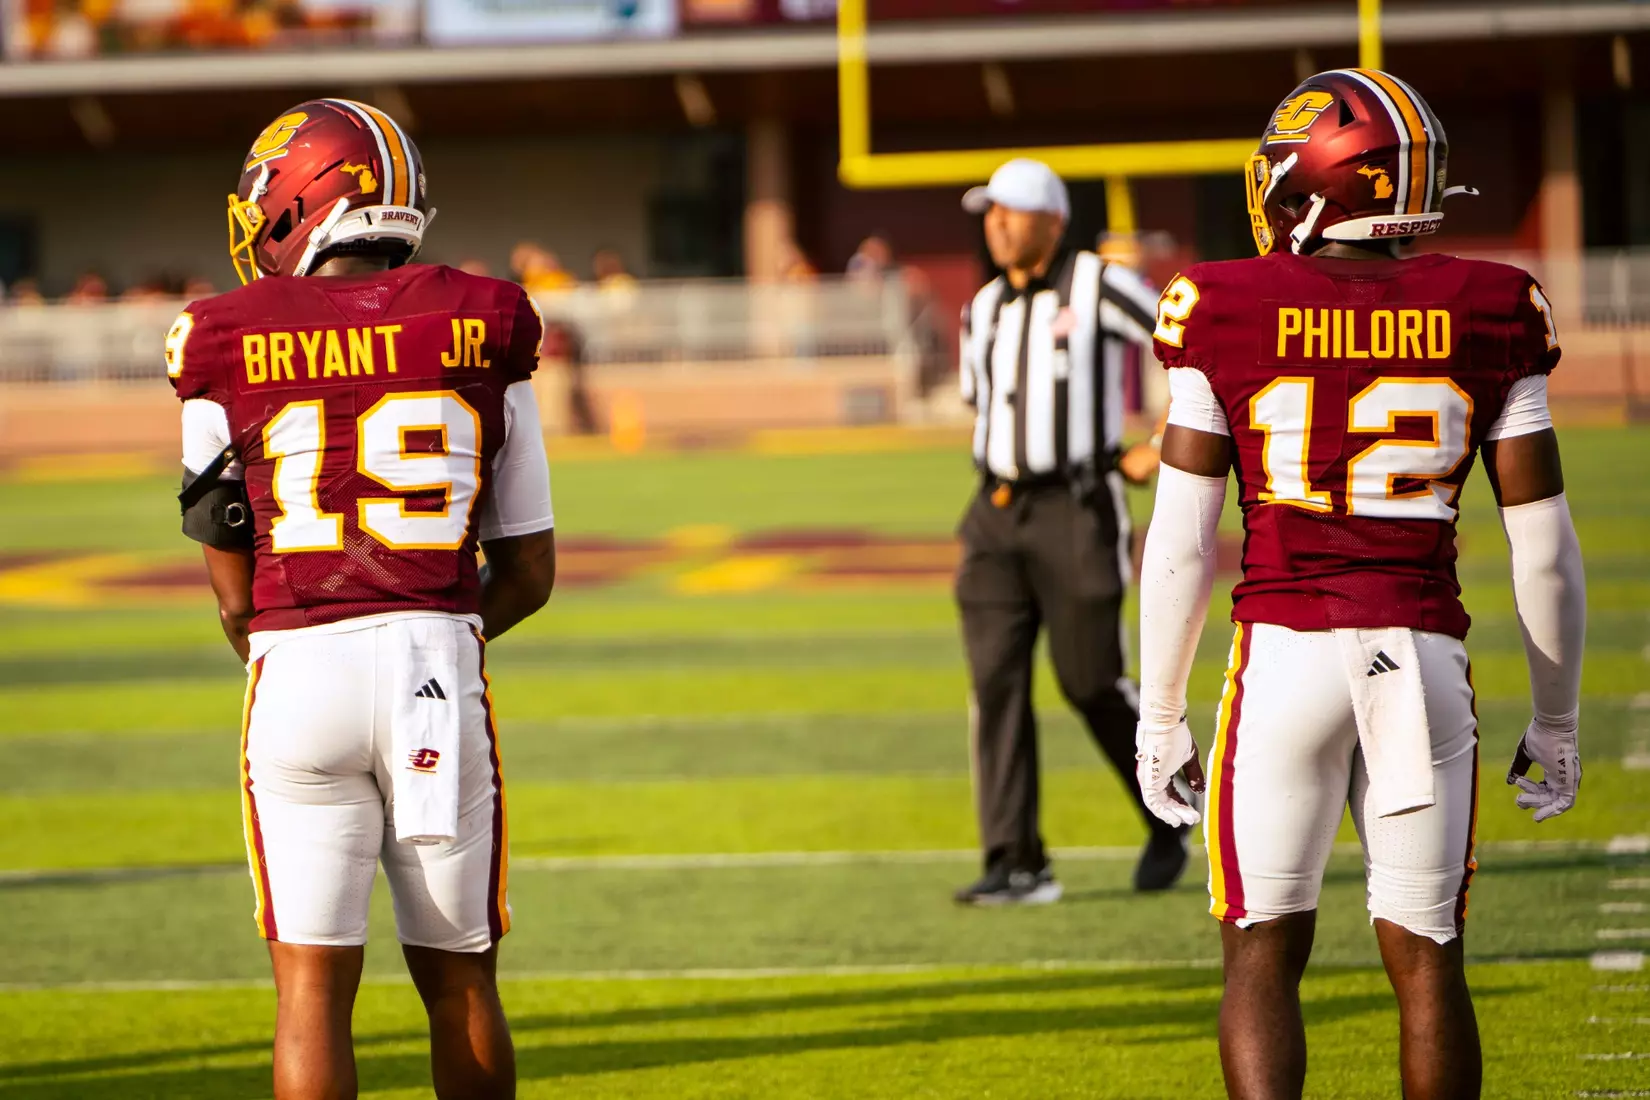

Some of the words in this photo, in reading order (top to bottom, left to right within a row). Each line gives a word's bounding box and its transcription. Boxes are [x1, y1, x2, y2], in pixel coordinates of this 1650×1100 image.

[242, 324, 402, 384] BRYANT
[440, 318, 491, 369] JR.
[1277, 308, 1451, 360] PHILORD
[262, 389, 482, 553] 19
[1248, 376, 1475, 524] 12
